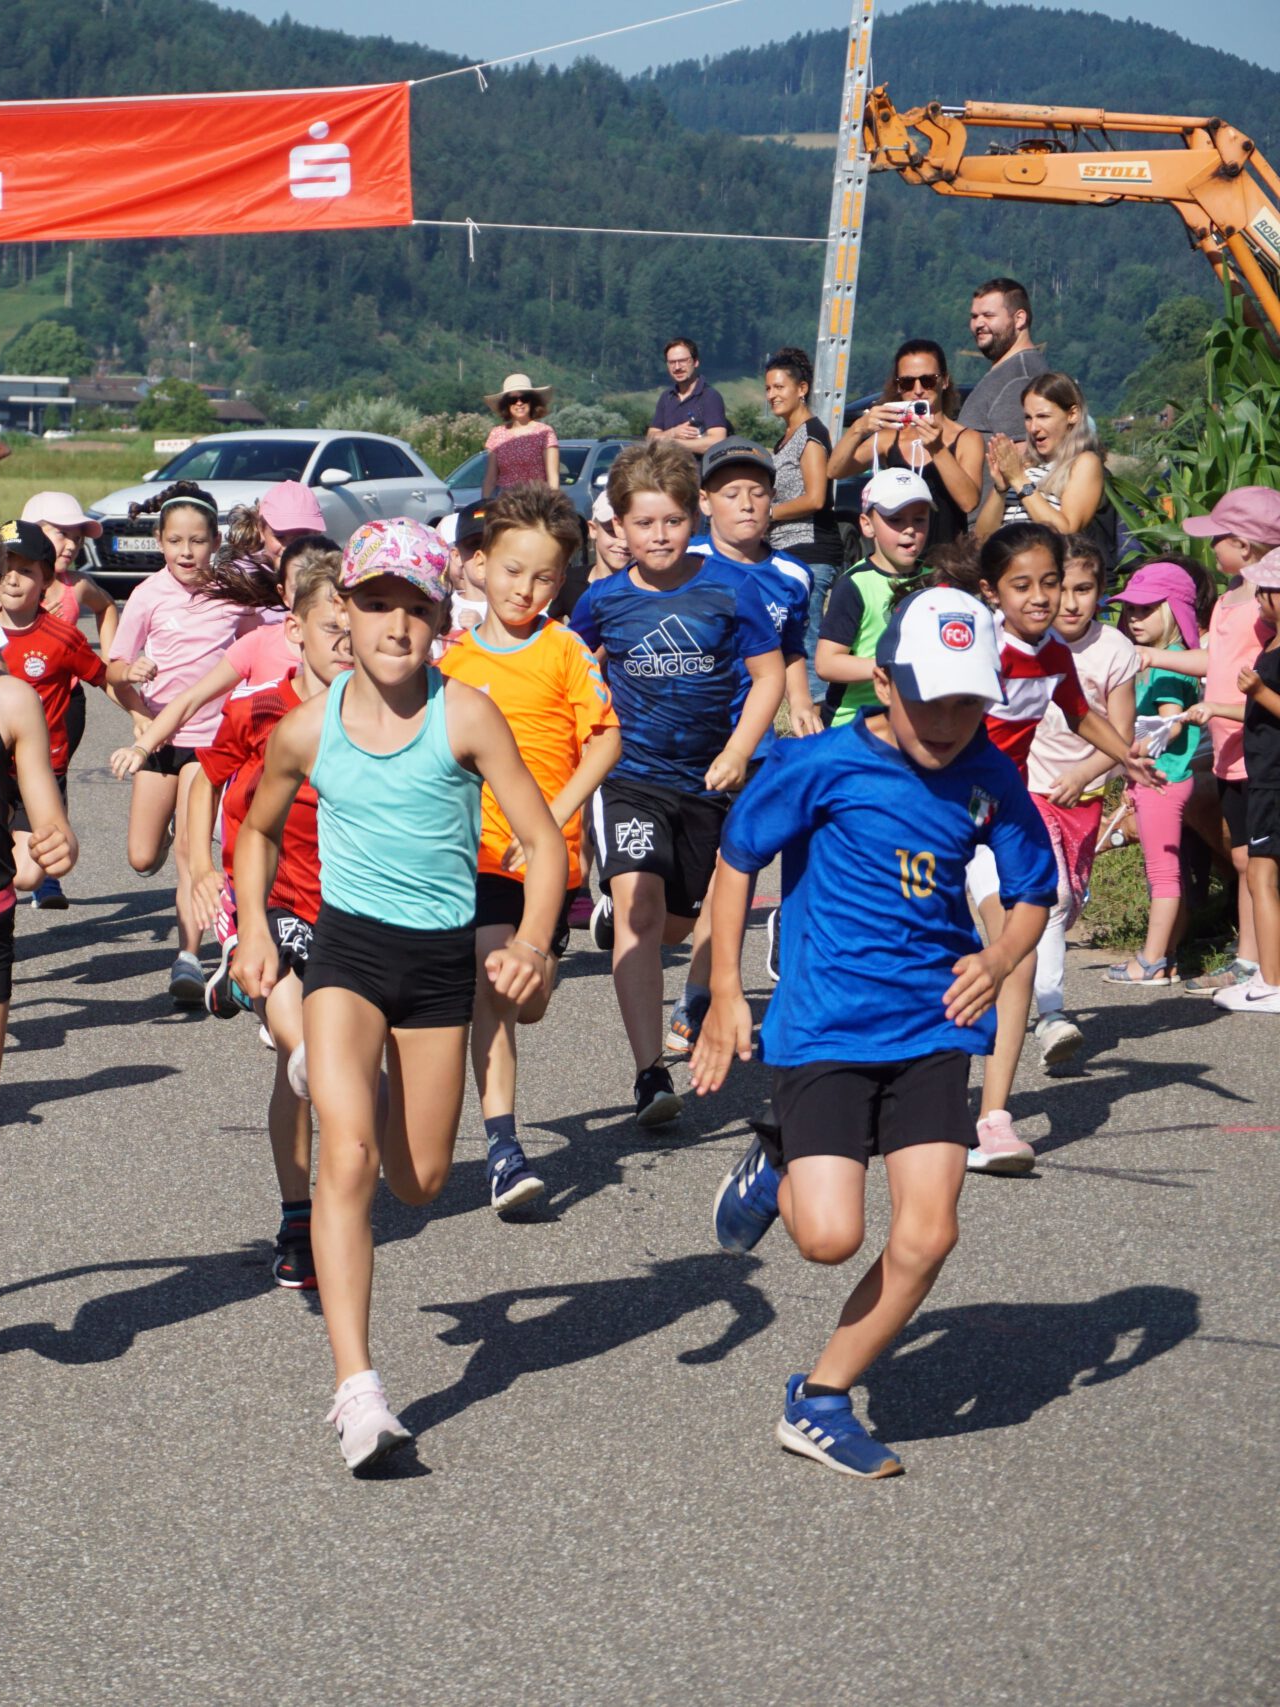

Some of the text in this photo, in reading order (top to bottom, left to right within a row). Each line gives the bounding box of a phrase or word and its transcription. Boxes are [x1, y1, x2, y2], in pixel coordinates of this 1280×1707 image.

[1082, 164, 1148, 178] STOLL
[945, 628, 970, 643] FCH
[623, 655, 716, 677] adidas
[895, 848, 937, 900] 10
